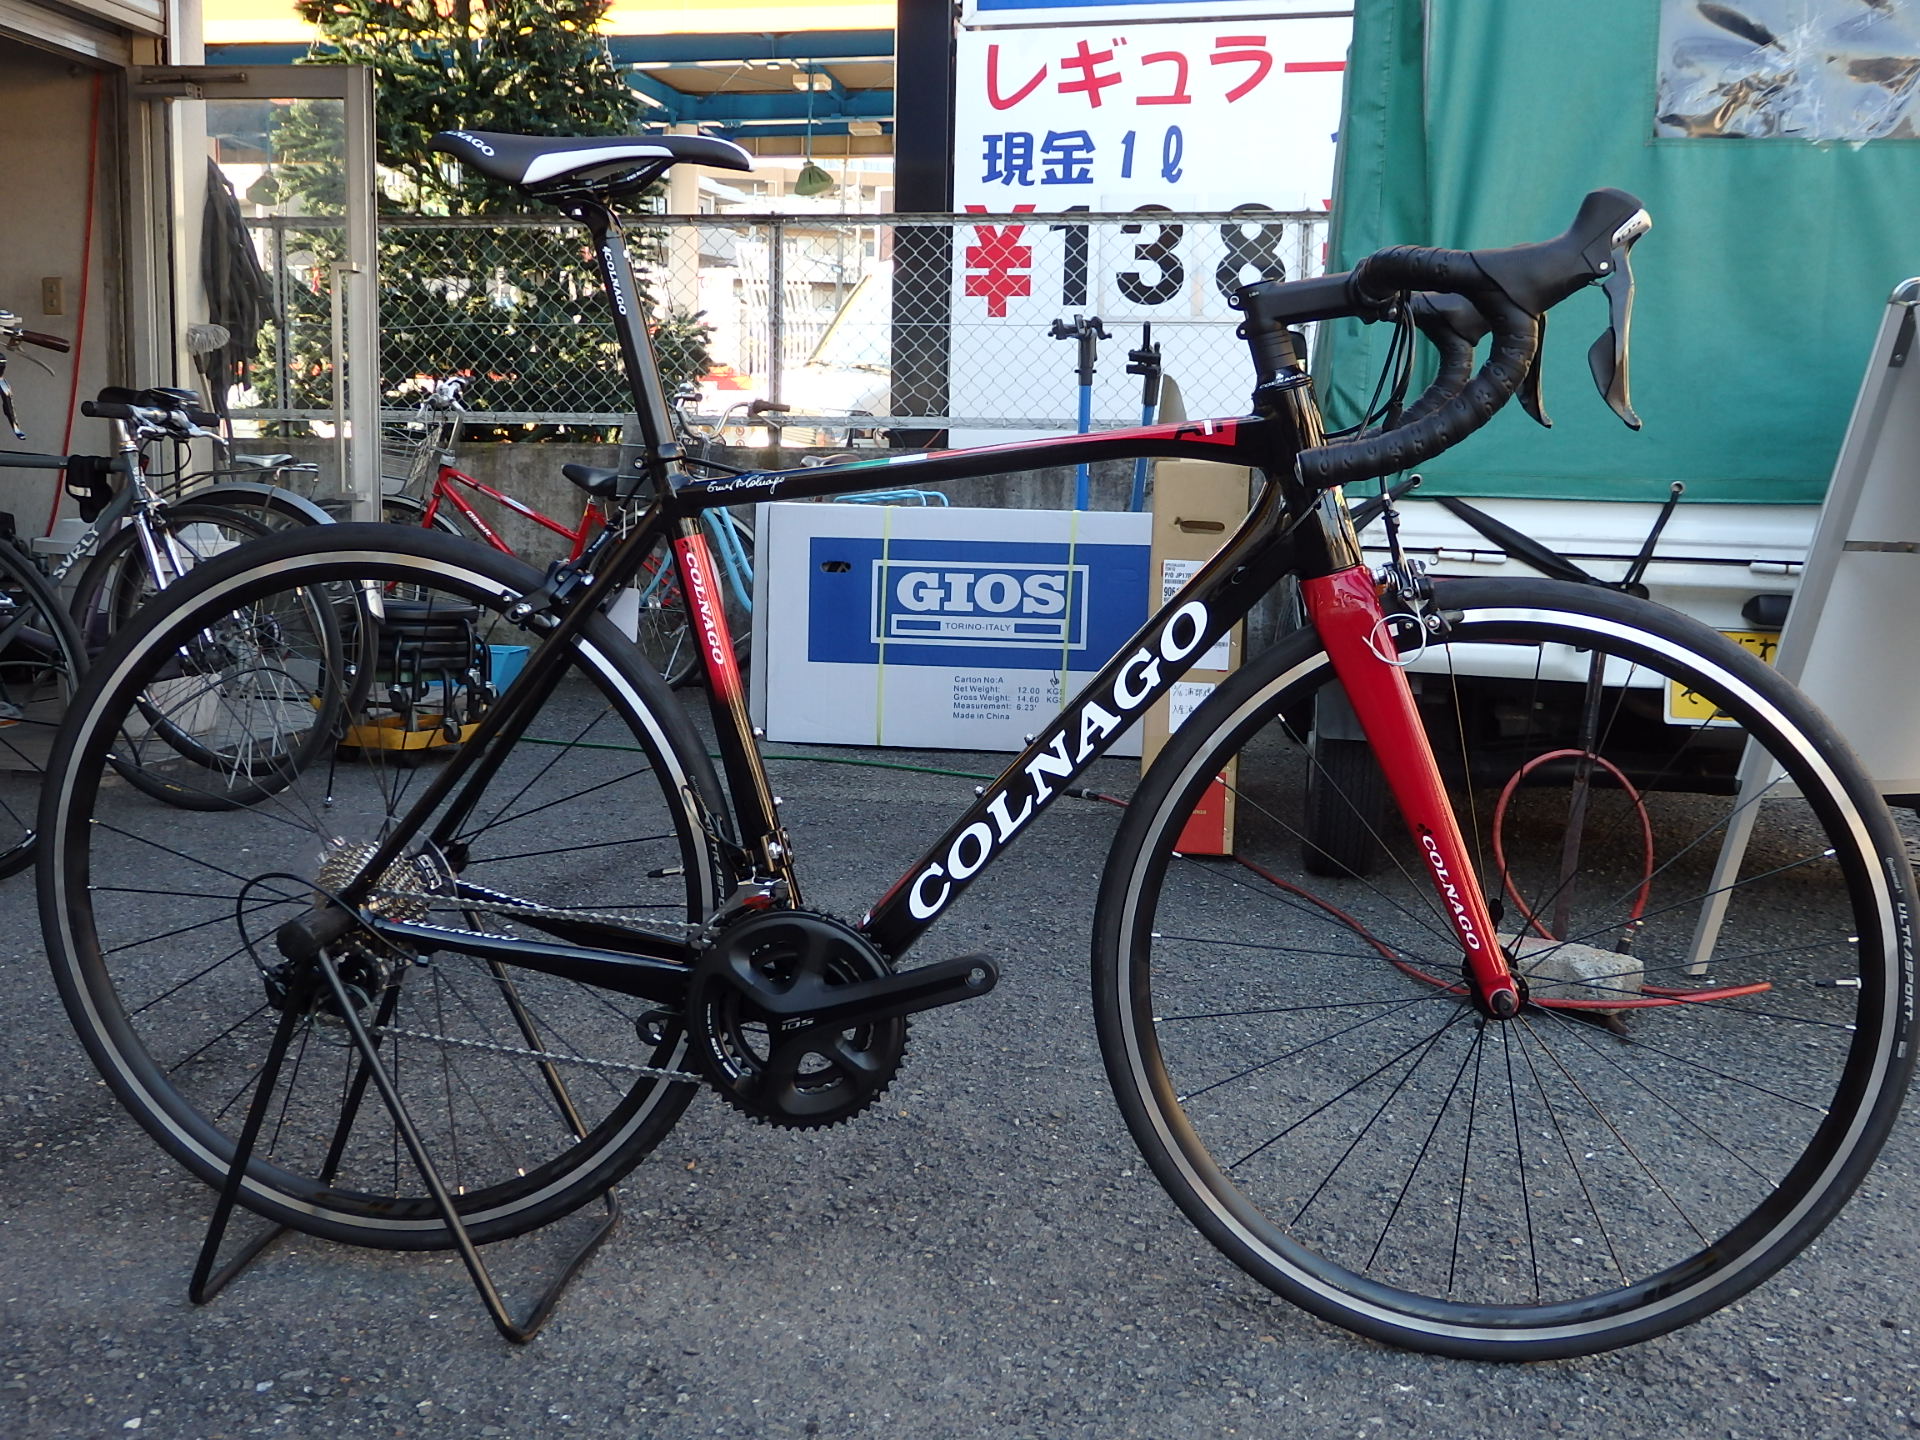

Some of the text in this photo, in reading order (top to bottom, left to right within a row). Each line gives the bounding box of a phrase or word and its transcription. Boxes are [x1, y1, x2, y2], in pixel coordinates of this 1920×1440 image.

[987, 36, 1347, 110] レギュラー
[982, 130, 1096, 186] 現金
[604, 252, 627, 316] COLNAGO
[53, 525, 100, 580] SURLY
[686, 552, 724, 665] COLNAGO
[896, 571, 1066, 615] GIOS
[945, 622, 1011, 632] TORINO-ITALY
[953, 685, 968, 693] Net
[1017, 687, 1040, 695] 12.00
[953, 694, 978, 702] Gross
[953, 702, 1012, 711] Measurement:
[954, 675, 982, 684] Carton
[952, 712, 1010, 721] Made in China
[909, 601, 1208, 919] COLNAGO
[1422, 835, 1480, 950] COLNAGO
[1897, 902, 1914, 1021] ULTRASPORT
